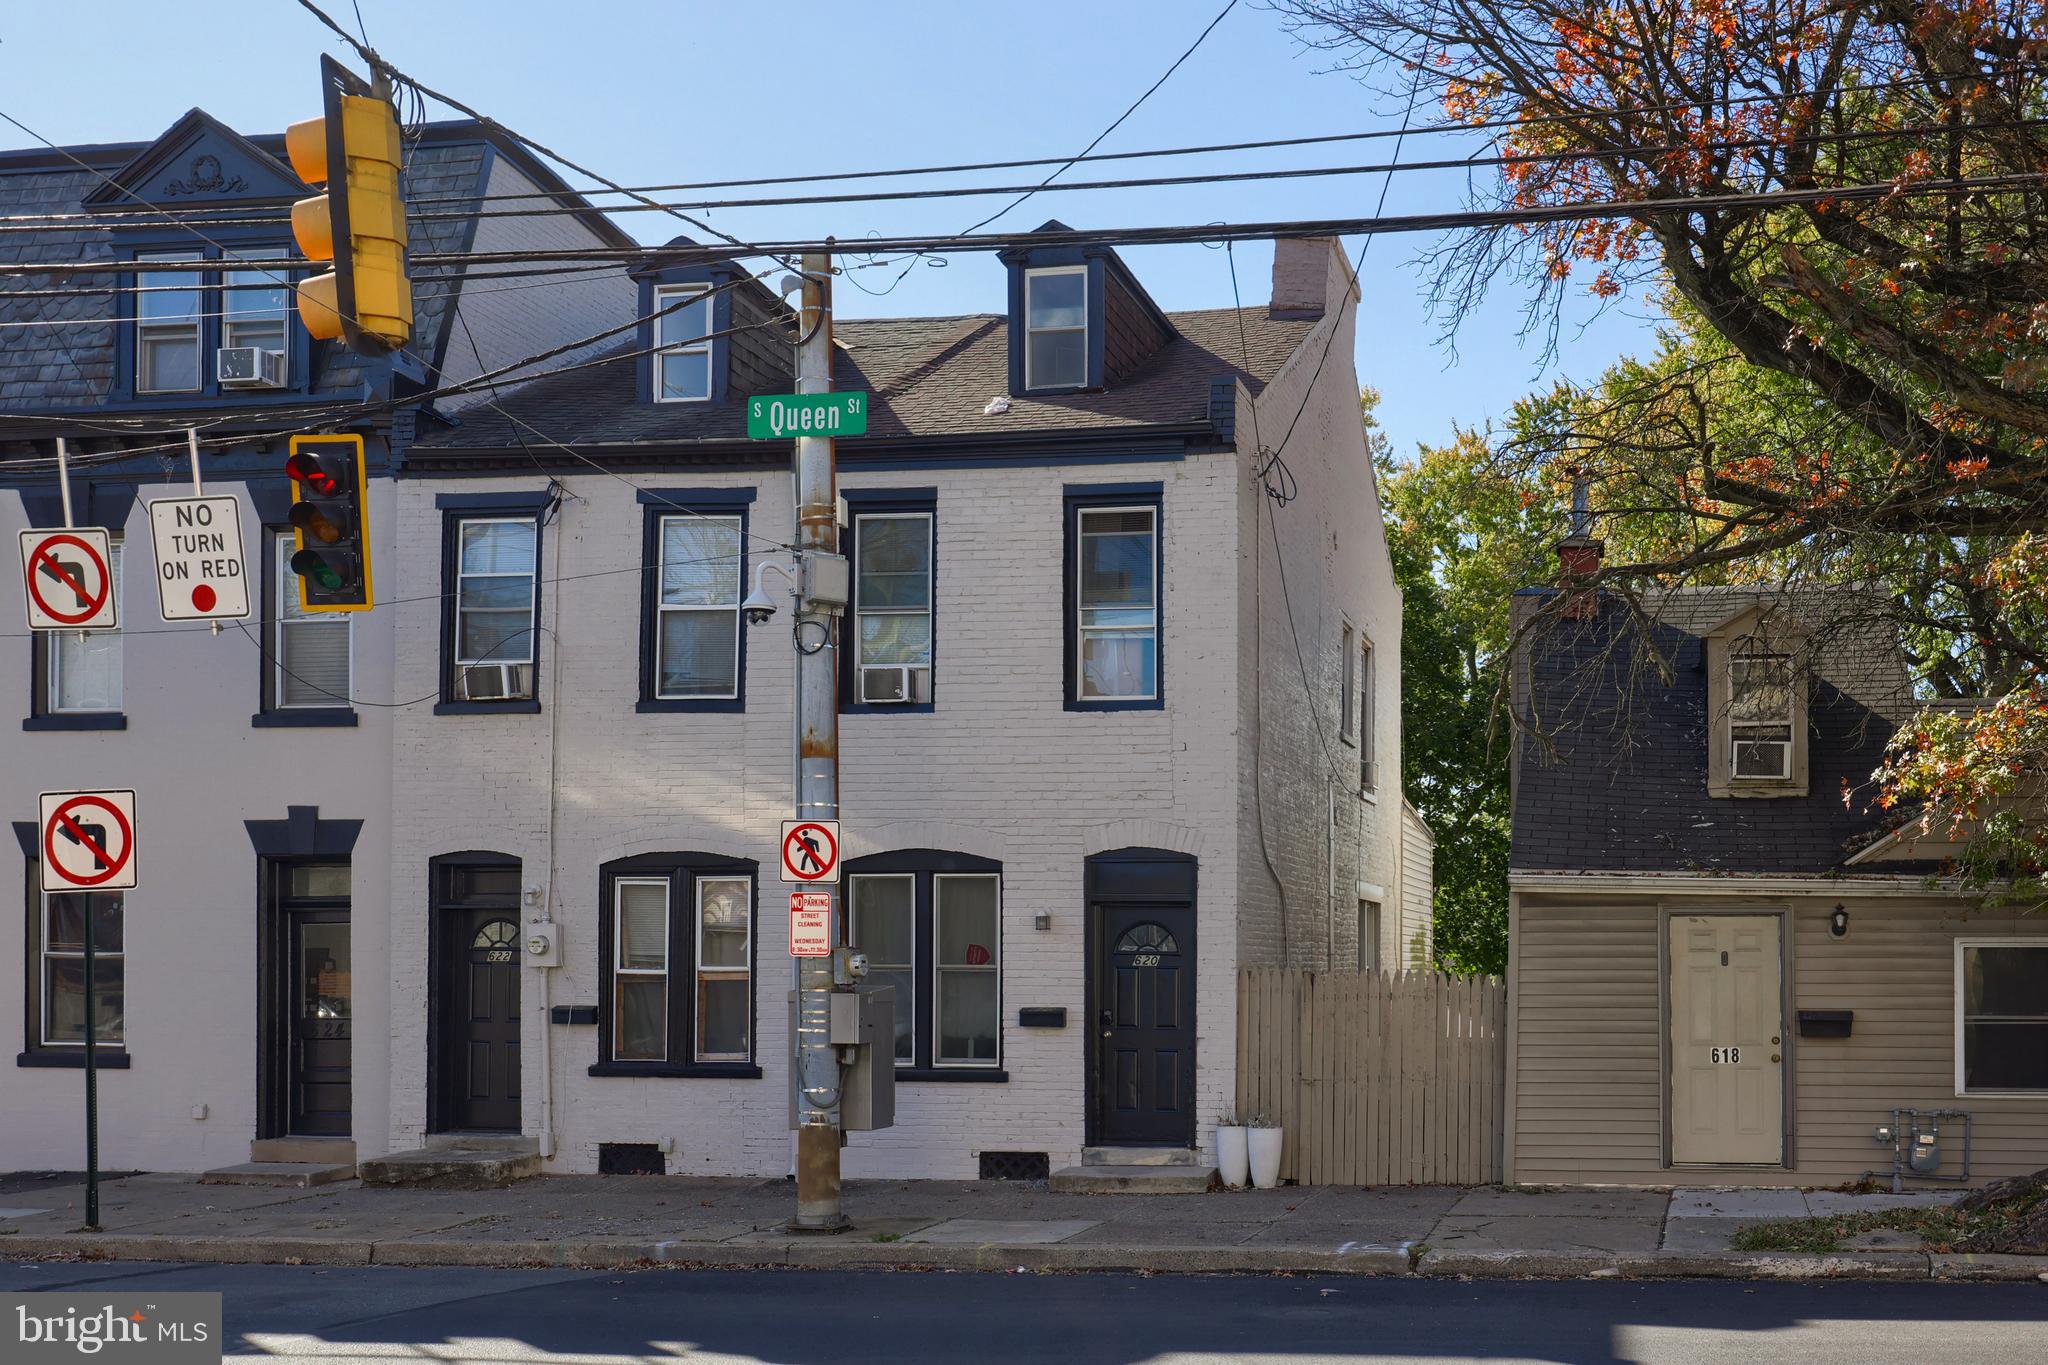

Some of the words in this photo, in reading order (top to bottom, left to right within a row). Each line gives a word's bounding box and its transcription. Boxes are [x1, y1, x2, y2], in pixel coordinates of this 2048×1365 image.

[754, 402, 762, 418] S
[770, 401, 840, 436] Queen
[847, 398, 860, 414] St
[175, 504, 213, 527] NO
[171, 533, 225, 554] TURN
[162, 561, 189, 580] ON
[201, 559, 240, 578] RED
[792, 896, 803, 909] NO
[803, 898, 828, 907] PARKING
[488, 951, 511, 961] 622
[1134, 955, 1159, 966] 620
[1711, 1047, 1740, 1064] 618
